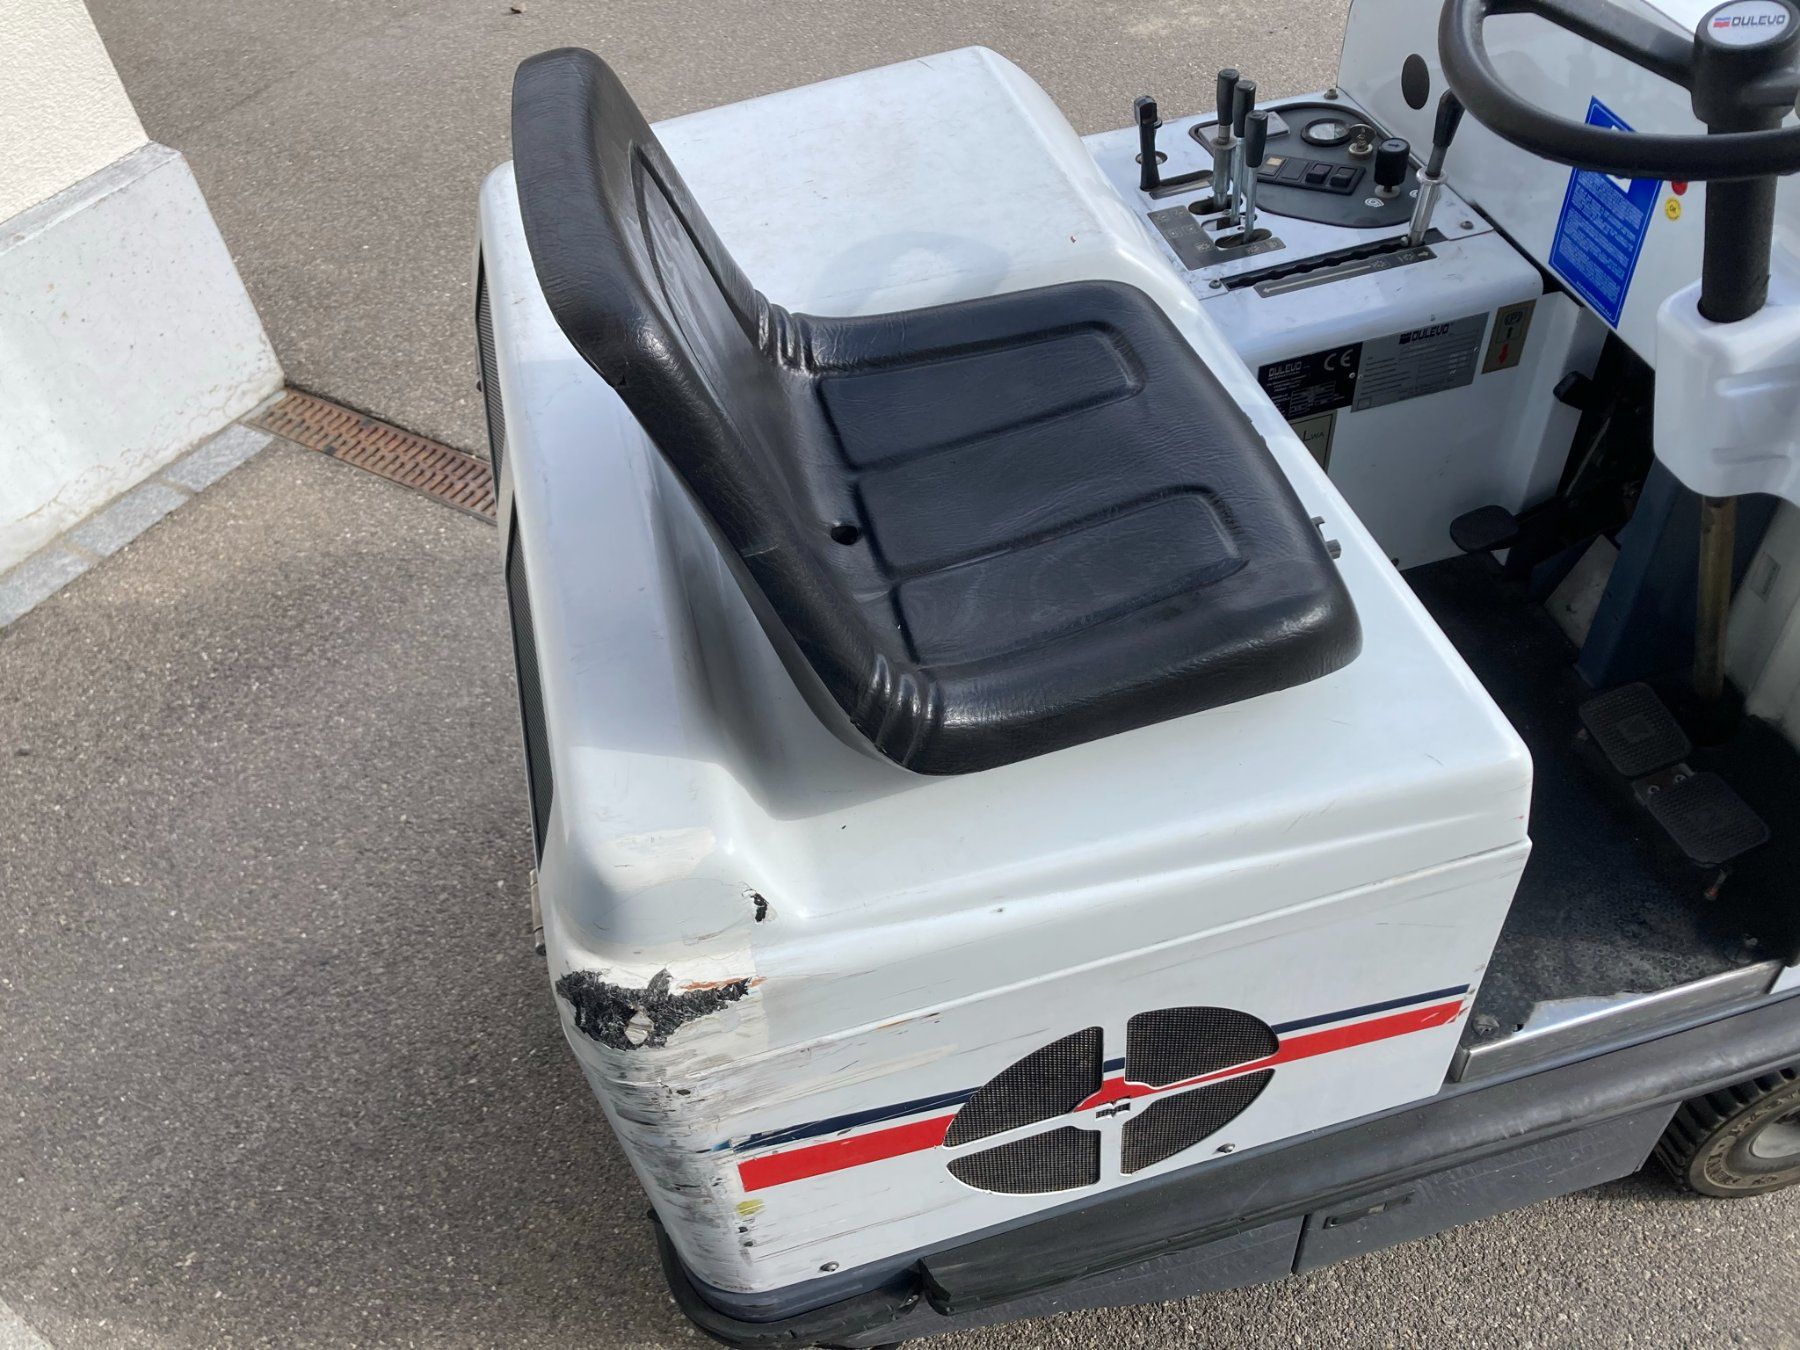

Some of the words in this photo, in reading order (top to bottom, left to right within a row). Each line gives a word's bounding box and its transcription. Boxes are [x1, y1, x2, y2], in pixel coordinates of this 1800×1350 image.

[1731, 15, 1786, 27] DULEVO
[1411, 323, 1450, 341] DULEVO
[1323, 349, 1354, 371] CE
[1268, 361, 1302, 377] DULEVO
